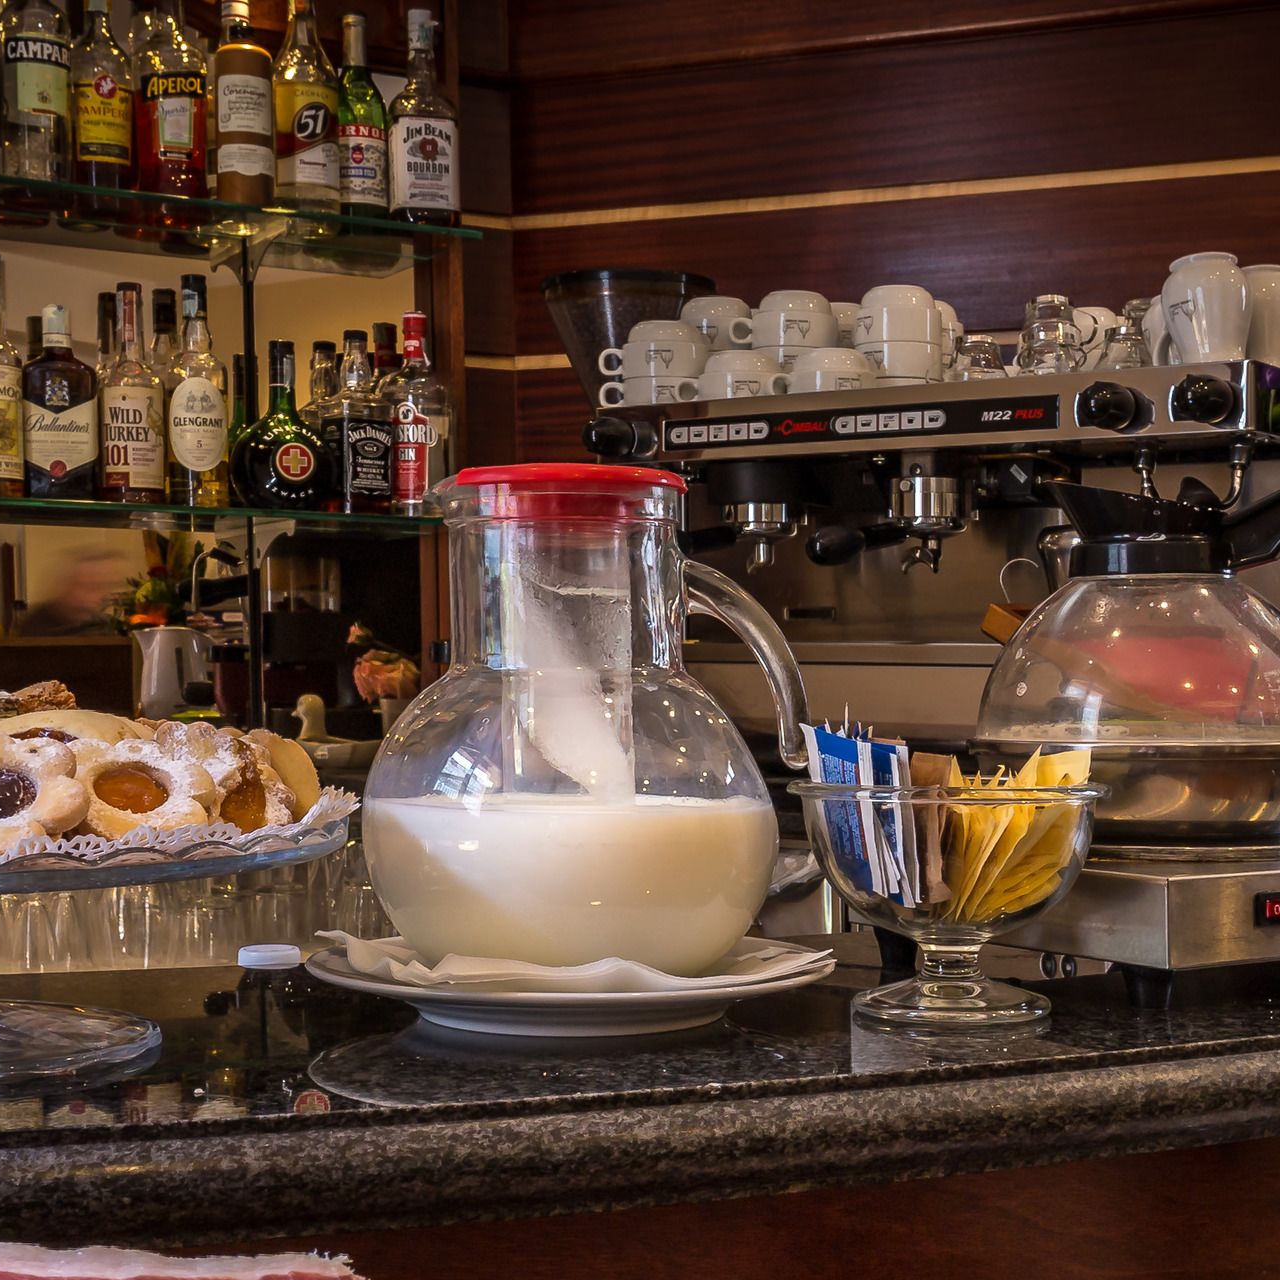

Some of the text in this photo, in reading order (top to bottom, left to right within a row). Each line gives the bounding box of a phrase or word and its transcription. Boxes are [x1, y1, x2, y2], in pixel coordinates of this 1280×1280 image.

[7, 39, 69, 66] CAMPAR
[147, 75, 203, 97] APEROL
[298, 108, 326, 137] 51
[402, 123, 452, 147] JIM BEAM
[407, 161, 450, 175] BOURBON
[109, 406, 143, 425] WILD
[981, 407, 1045, 422] M22 PLUS
[104, 423, 151, 443] TURKEY
[263, 425, 323, 447] UNICUM
[105, 443, 130, 466] 101
[399, 448, 417, 461] GIN
